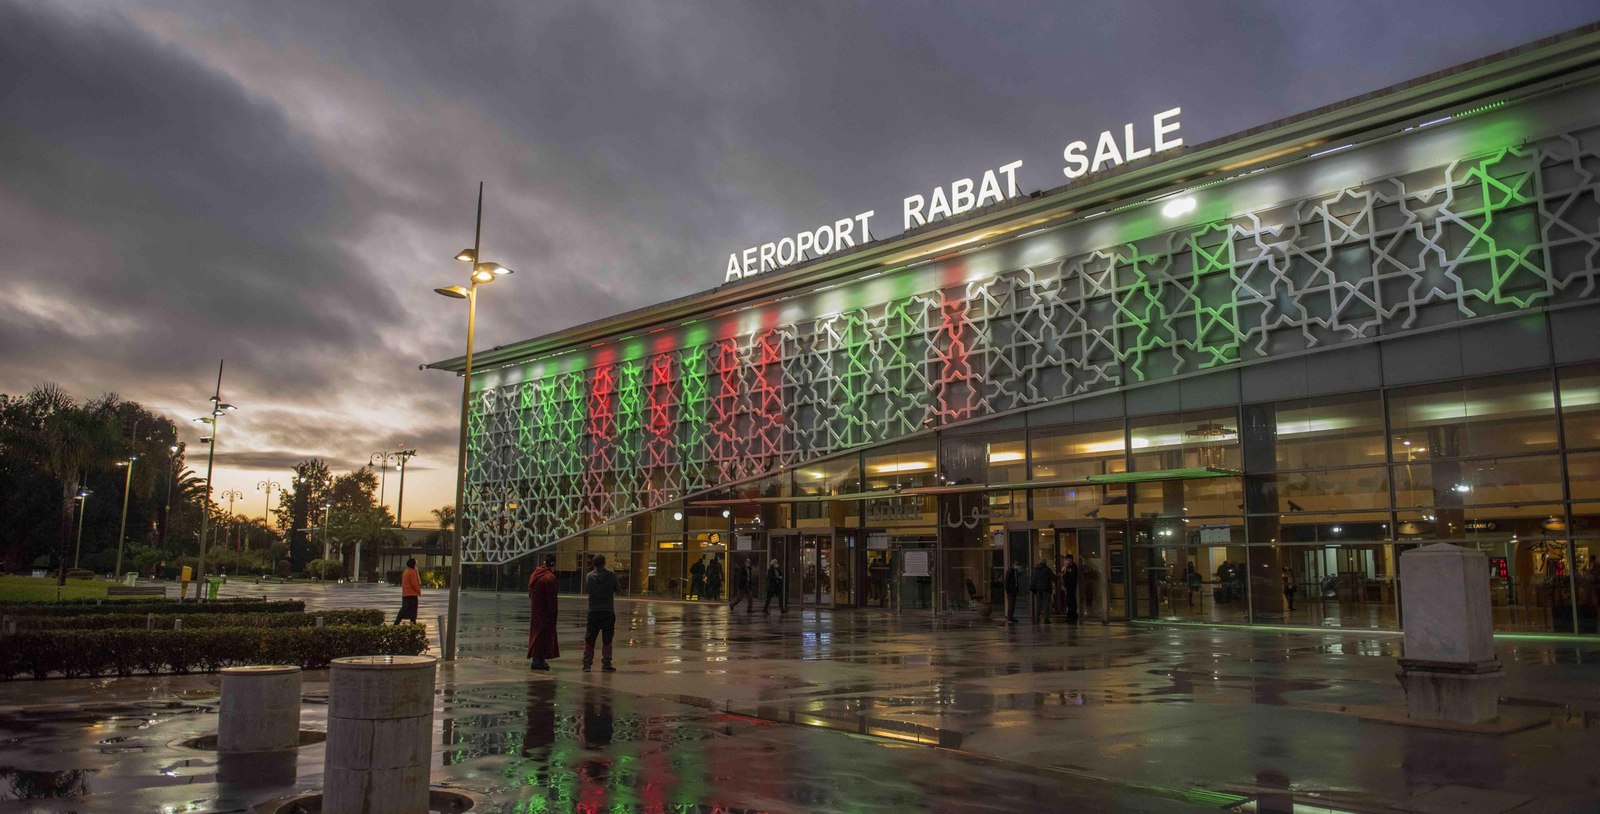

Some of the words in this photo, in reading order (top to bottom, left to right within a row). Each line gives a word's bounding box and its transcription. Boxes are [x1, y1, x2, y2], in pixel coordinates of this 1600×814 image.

[725, 211, 875, 282] AEROPORT
[904, 160, 1023, 229] RABAT
[1063, 107, 1183, 178] SALE
